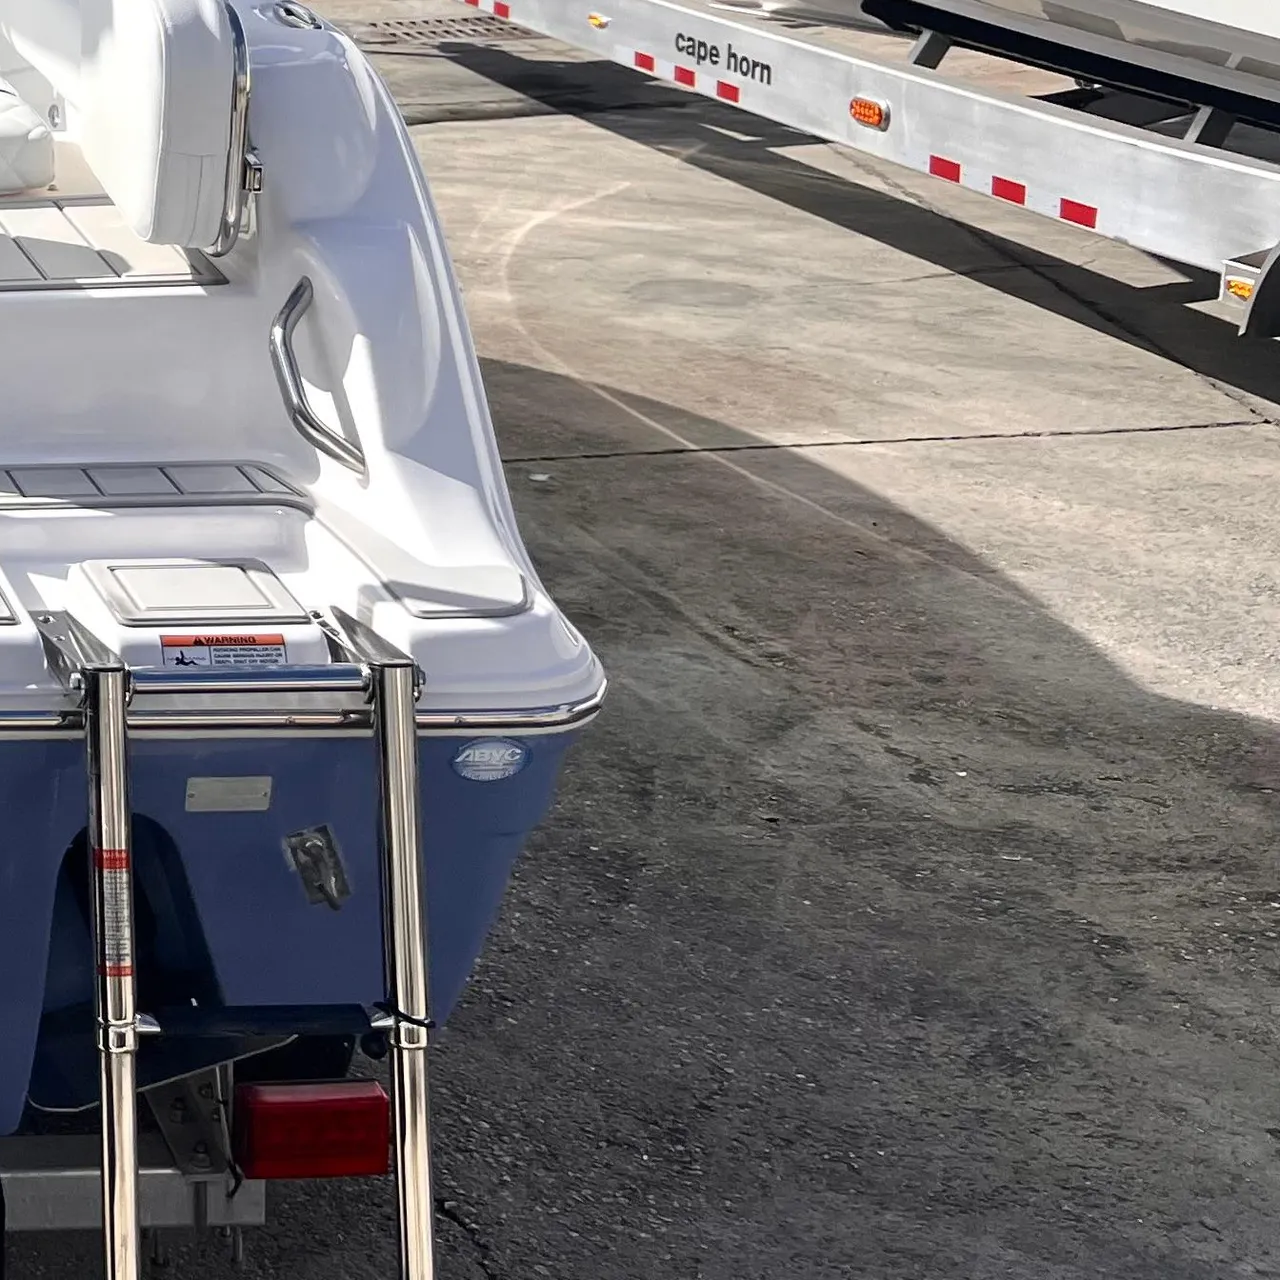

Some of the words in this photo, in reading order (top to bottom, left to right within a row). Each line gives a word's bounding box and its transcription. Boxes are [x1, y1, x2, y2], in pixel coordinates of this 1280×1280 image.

[675, 32, 720, 65] cape
[726, 42, 772, 86] horn
[203, 636, 257, 644] WARNING
[454, 747, 522, 762] ABYC
